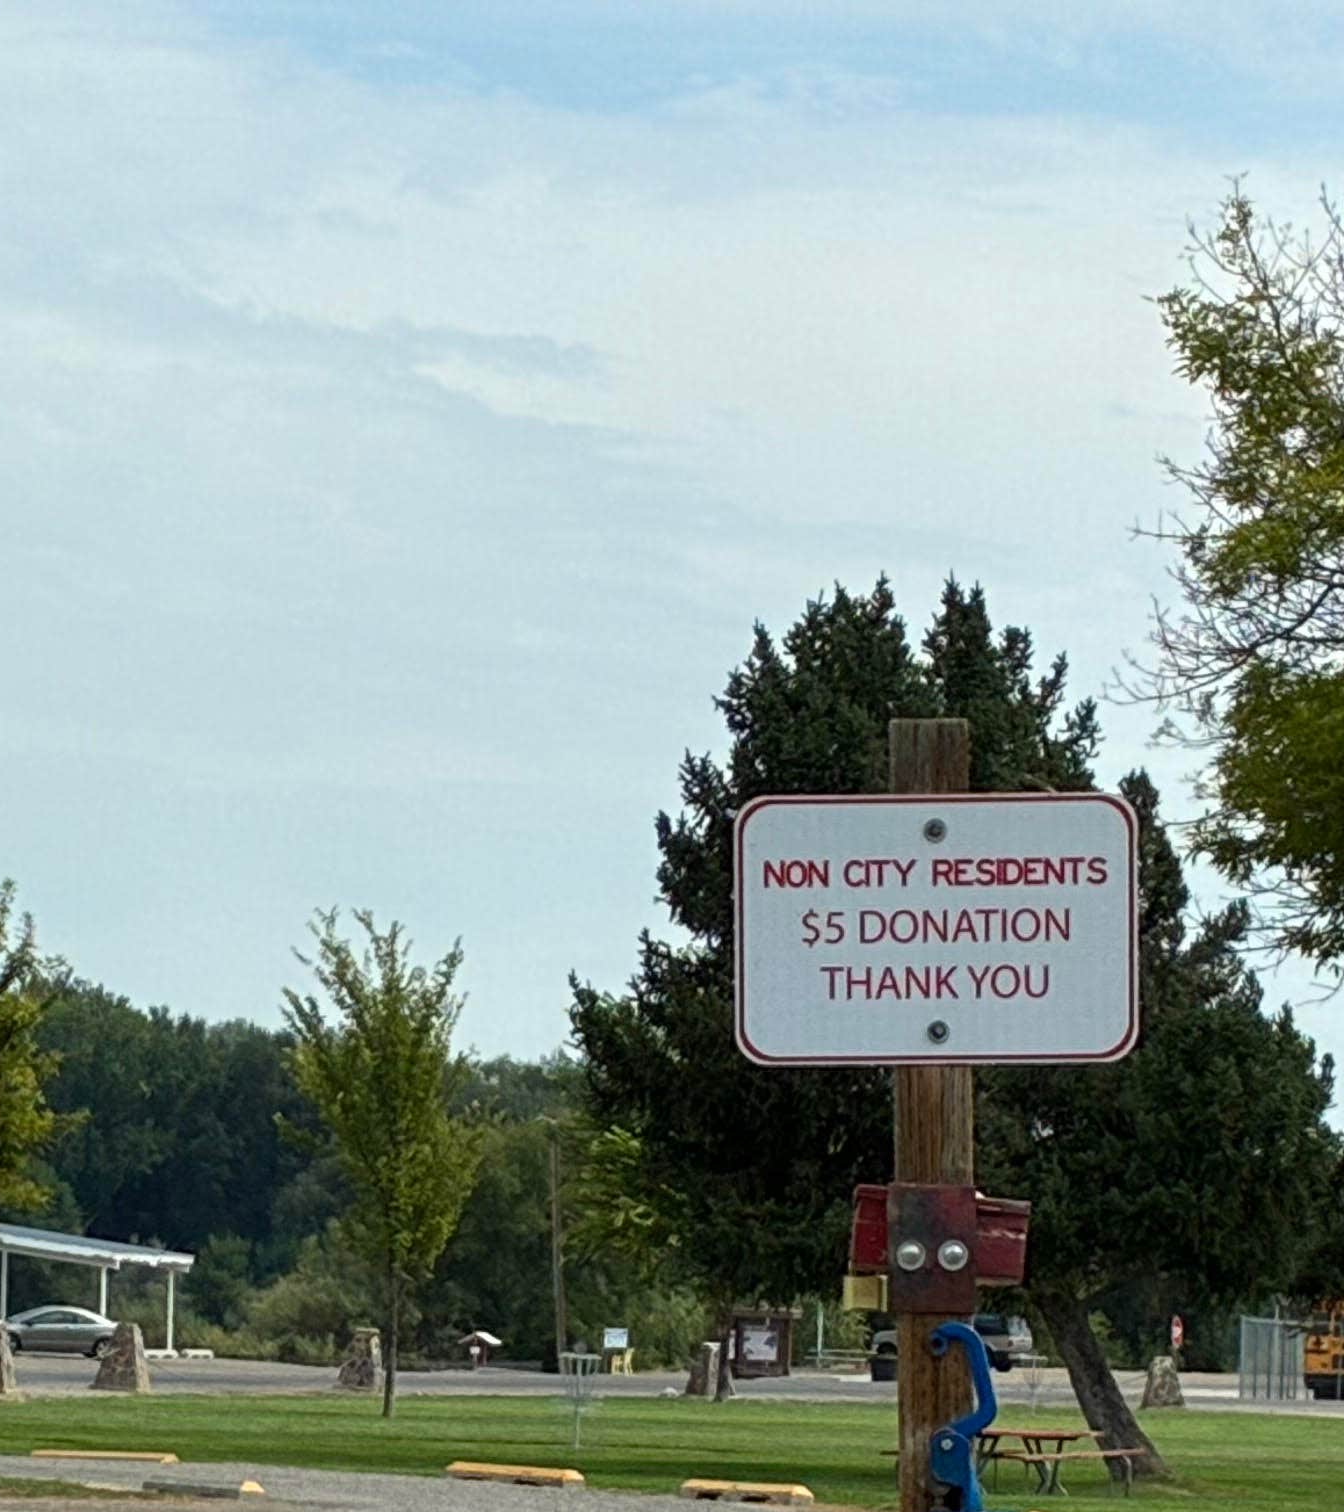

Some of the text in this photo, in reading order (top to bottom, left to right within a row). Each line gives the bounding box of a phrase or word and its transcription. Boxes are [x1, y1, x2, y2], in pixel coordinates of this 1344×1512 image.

[763, 856, 1108, 889] NON CITY RESIDENTS
[801, 907, 1071, 948] $5 DONATION
[819, 963, 1050, 1001] THANK YOU
